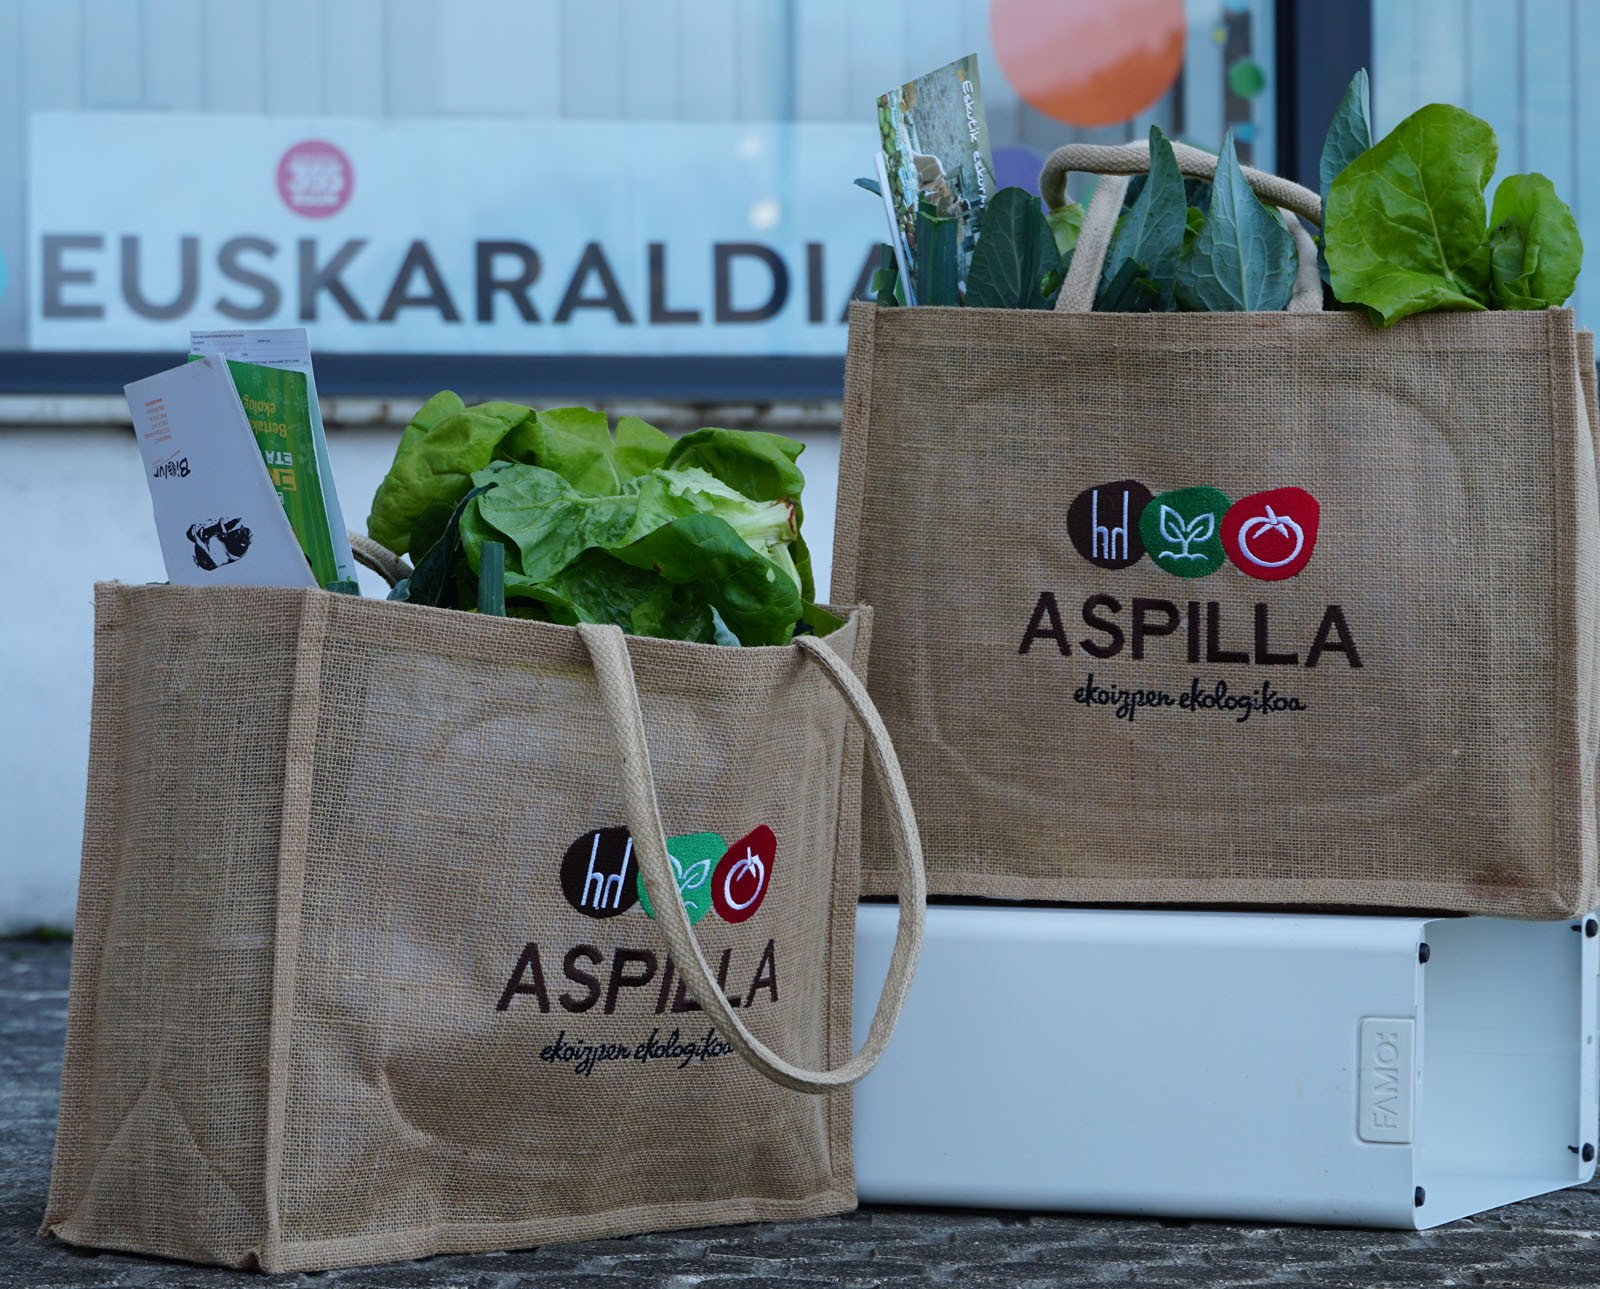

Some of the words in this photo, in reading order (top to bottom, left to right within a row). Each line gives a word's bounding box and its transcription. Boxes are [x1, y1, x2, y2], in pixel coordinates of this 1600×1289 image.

[962, 80, 979, 144] Eskutik
[265, 450, 293, 466] ETA
[1018, 591, 1363, 668] ASPILLA
[1074, 673, 1174, 721] ekoizpen
[1178, 677, 1306, 722] ekologikoa
[540, 1030, 631, 1076] ekoizpen
